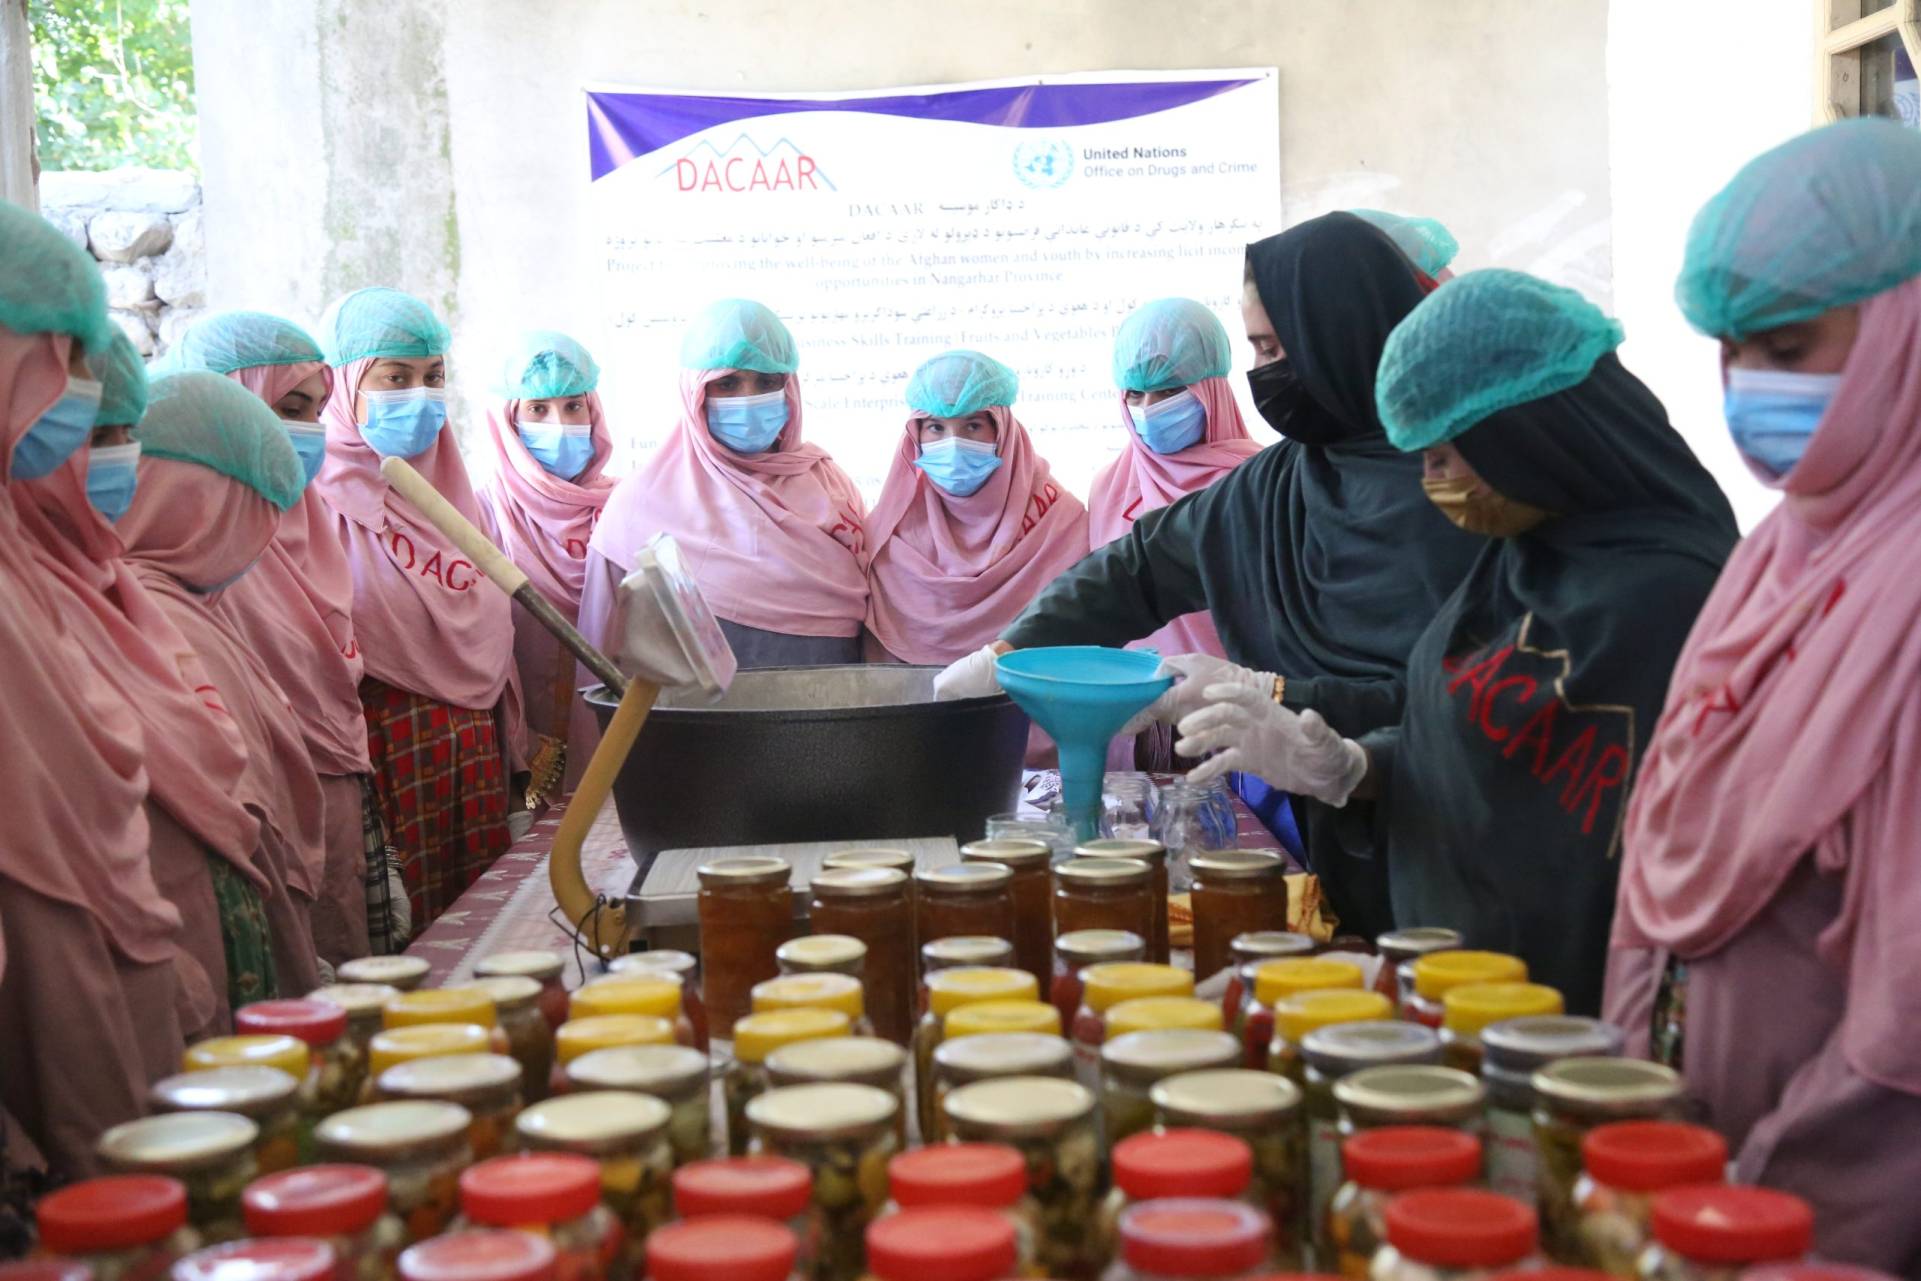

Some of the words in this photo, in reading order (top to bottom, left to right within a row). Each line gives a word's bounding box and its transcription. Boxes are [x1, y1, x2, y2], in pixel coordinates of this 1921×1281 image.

[1083, 147, 1129, 161] United
[1133, 145, 1188, 159] Nations
[677, 155, 818, 192] DACAAR
[1083, 165, 1124, 178] Office
[1127, 166, 1145, 177] on
[1148, 163, 1187, 179] Drugs
[1191, 160, 1215, 175] and
[1218, 160, 1258, 174] Crime
[960, 250, 1009, 265] women
[912, 273, 928, 287] in
[1440, 641, 1630, 836] ACAAR
